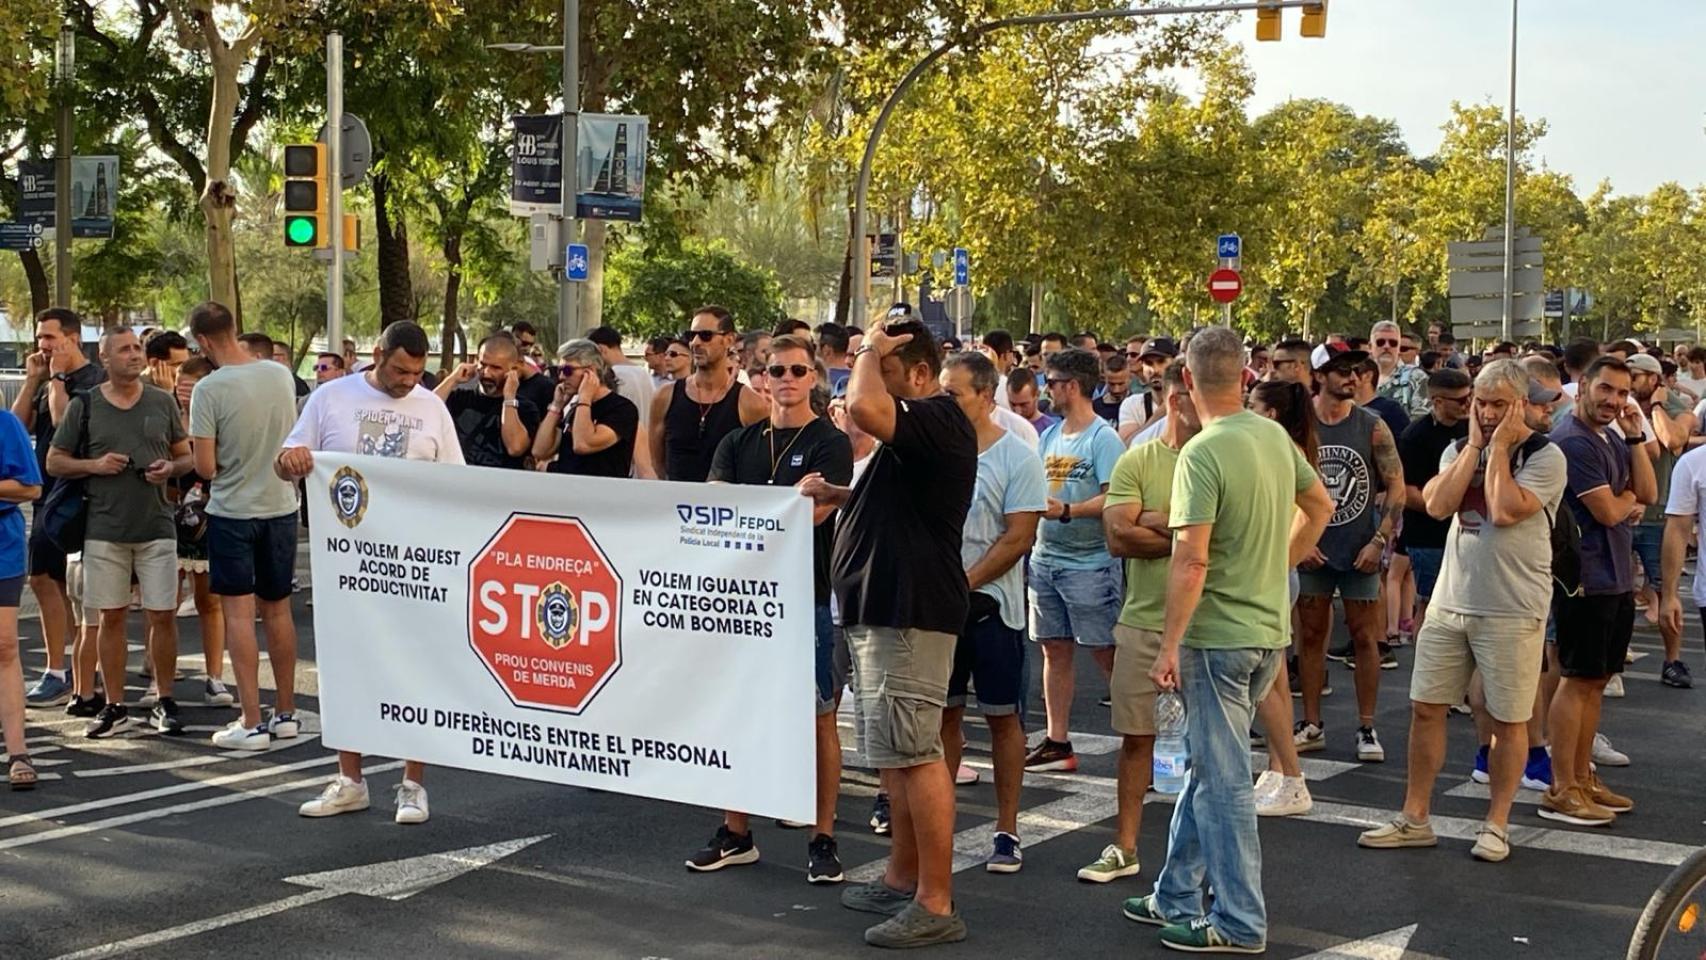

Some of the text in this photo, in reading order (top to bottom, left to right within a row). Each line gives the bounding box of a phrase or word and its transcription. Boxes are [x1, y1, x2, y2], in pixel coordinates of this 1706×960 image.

[680, 525, 706, 535] Sindicat
[708, 528, 746, 538] Independent
[739, 516, 785, 532] FEPOL
[327, 537, 461, 566] NO VOLEM AQUEST
[703, 537, 720, 547] Local
[359, 559, 430, 582] ACORD DE
[639, 569, 778, 598] VOLEM IGUALTAT
[339, 576, 448, 603] PRODUCTIVITAT
[633, 588, 784, 619] EN CATEGORIA C1
[643, 610, 773, 638] COM BOMBERS
[495, 653, 594, 677] PROU CONVENIS
[513, 670, 576, 689] DE MERDA
[380, 702, 732, 770] PROU DIFERÈNCIES ENTRE EL PERSONAL
[472, 737, 631, 778] DE L'AJUNTAMENT
